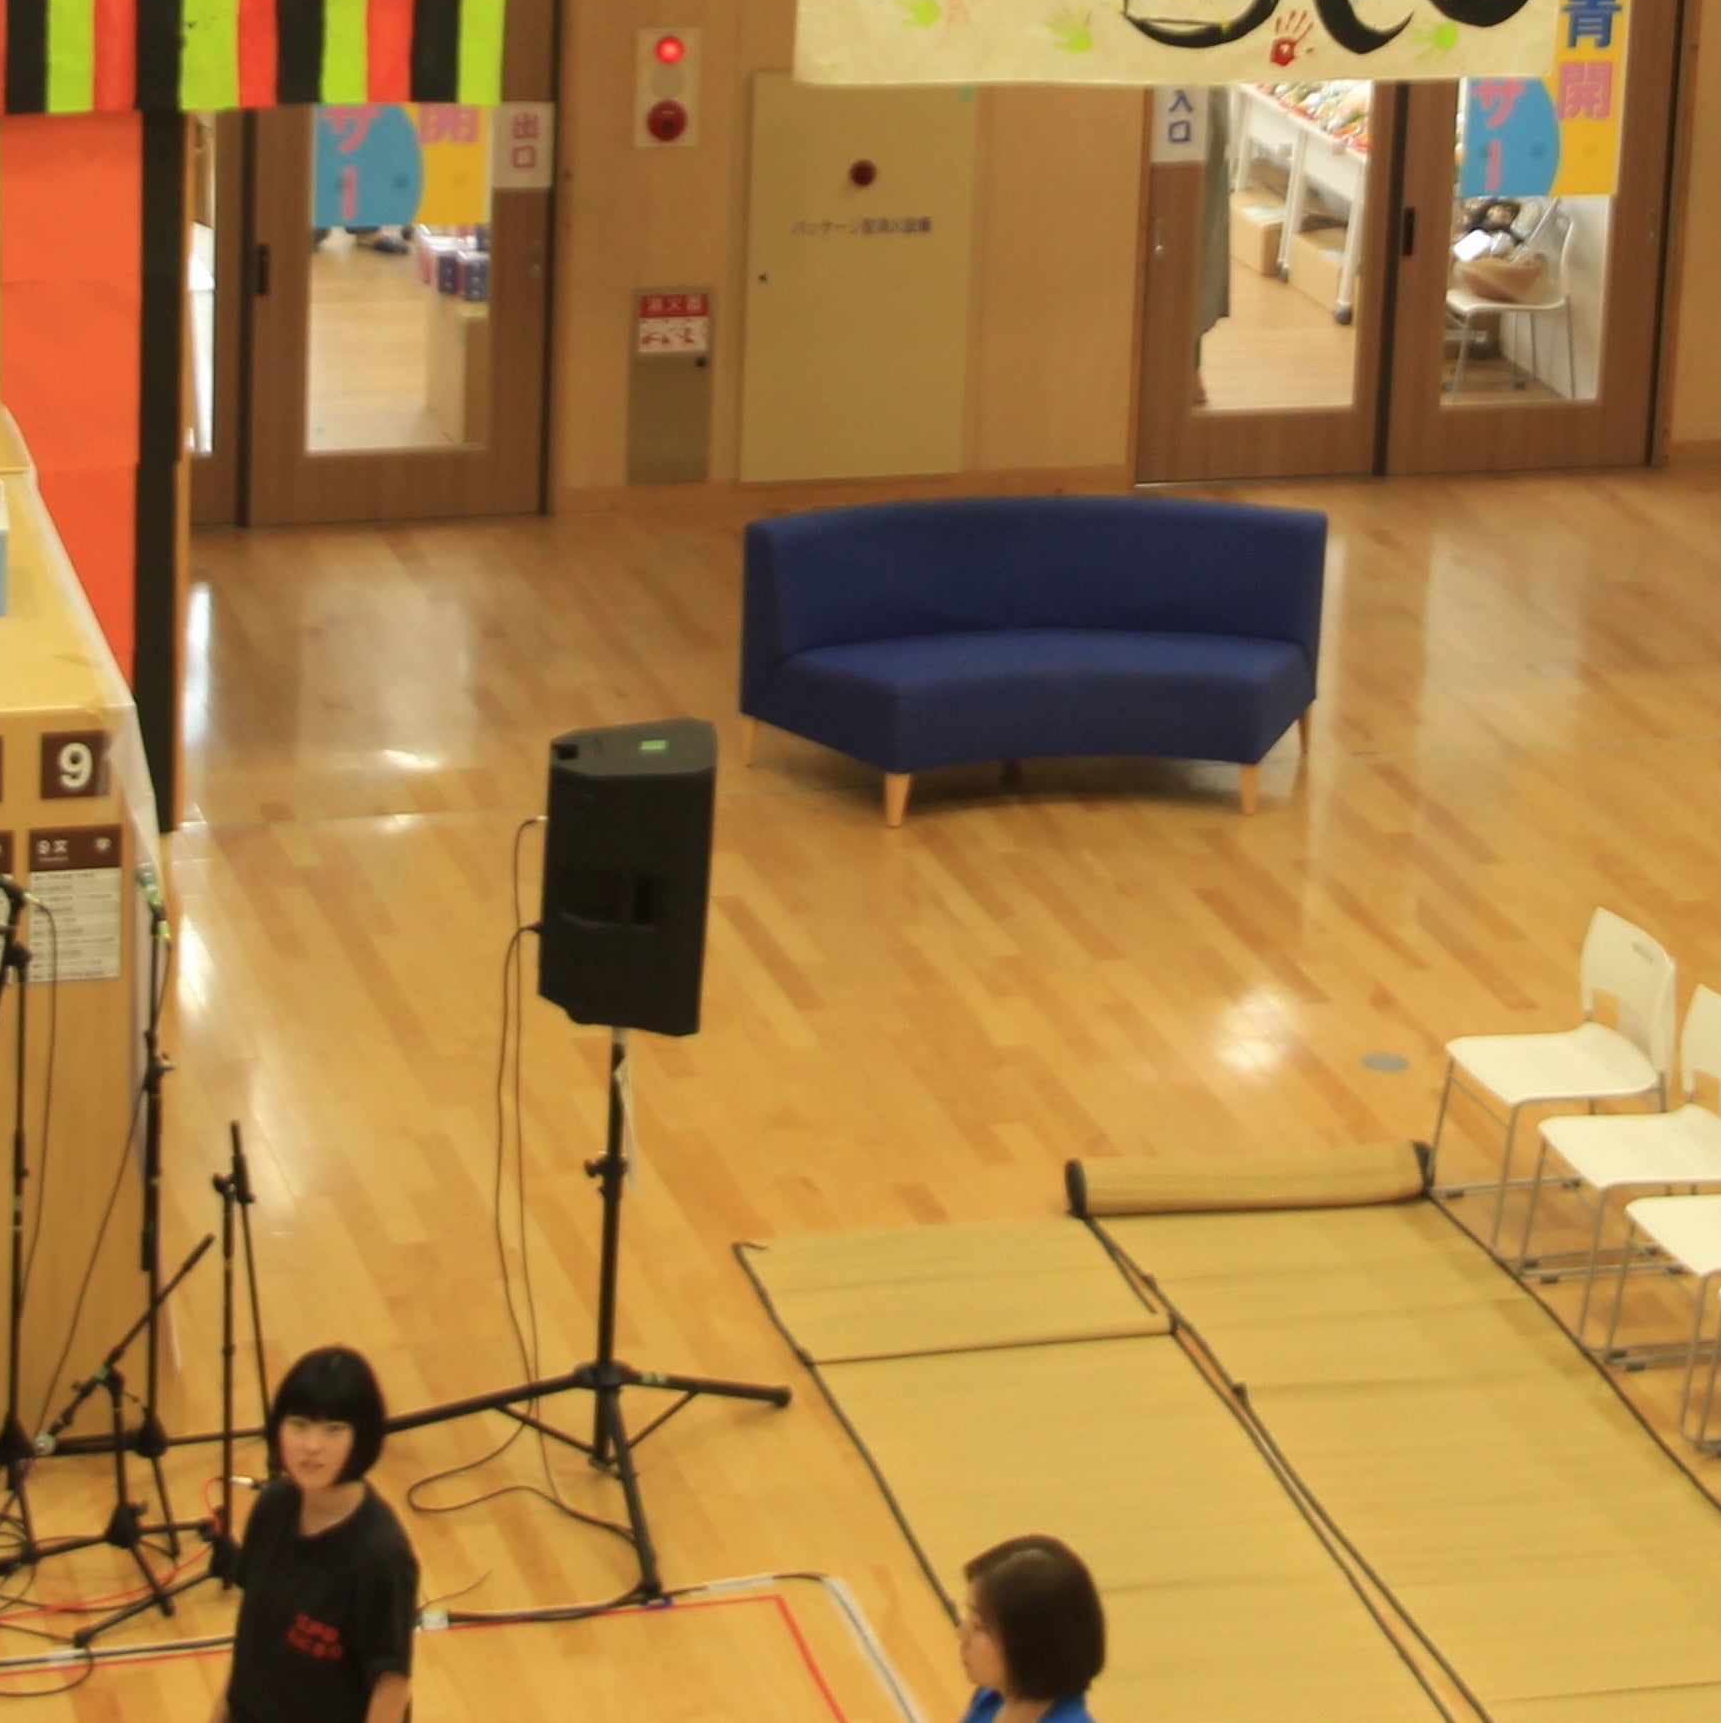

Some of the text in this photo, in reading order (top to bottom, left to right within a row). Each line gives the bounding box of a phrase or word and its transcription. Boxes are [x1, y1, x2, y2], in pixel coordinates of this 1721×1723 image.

[510, 111, 539, 170] 出口
[1167, 89, 1193, 144] 入口
[57, 741, 93, 790] 9
